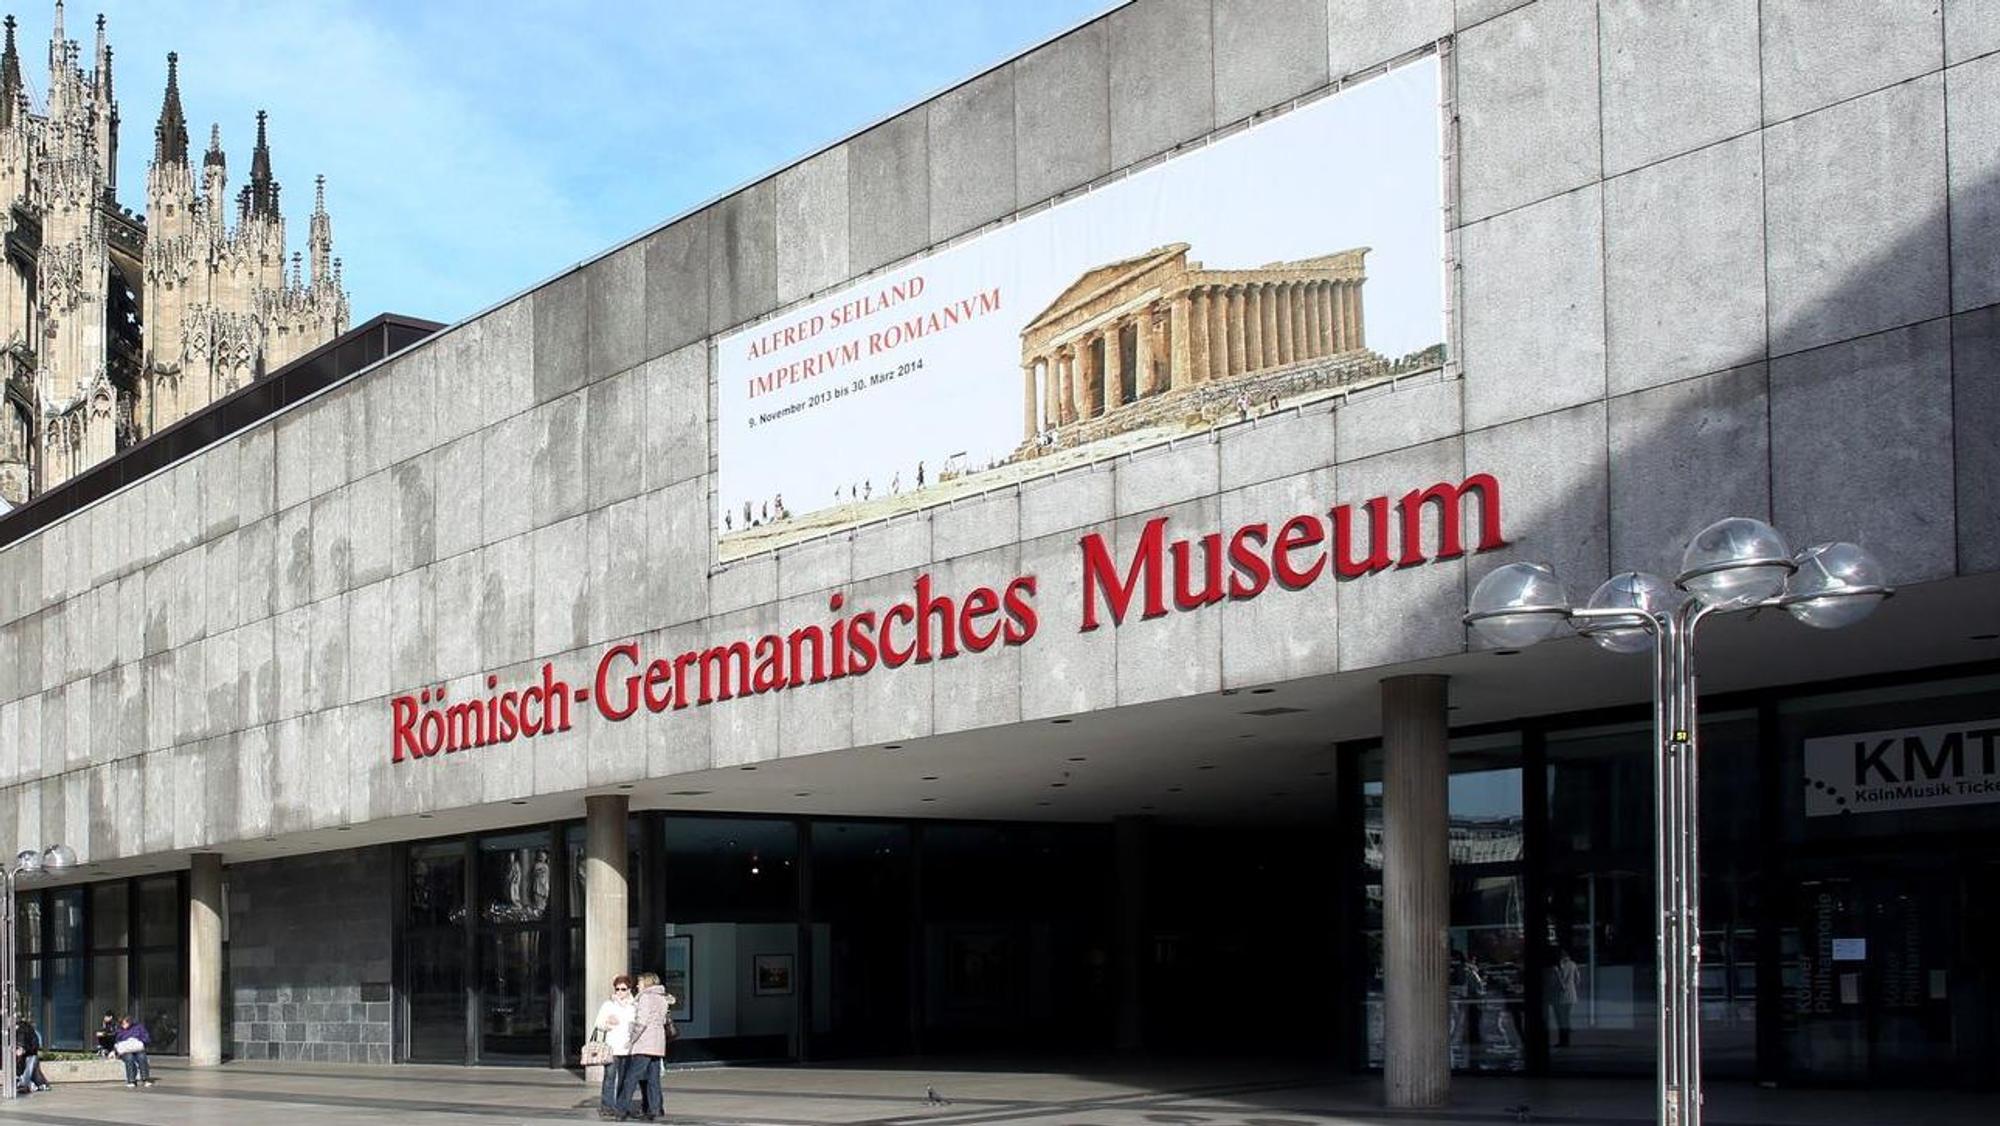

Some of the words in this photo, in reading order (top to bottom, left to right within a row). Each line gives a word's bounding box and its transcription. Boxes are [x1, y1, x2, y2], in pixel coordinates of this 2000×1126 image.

[747, 315, 825, 360] ALFRED
[830, 276, 925, 329] SEILAND
[748, 341, 860, 399] IMPERIVM
[869, 287, 1001, 356] ROMANVM
[748, 417, 756, 428] 9.
[759, 400, 806, 425] November
[808, 390, 832, 408] 2013
[834, 385, 849, 399] bis
[851, 379, 867, 392] 30.
[897, 358, 923, 377] 2014
[391, 573, 1039, 763] Römisch-Germanisches
[1078, 472, 1512, 633] Museum
[1855, 728, 2000, 785] KMT
